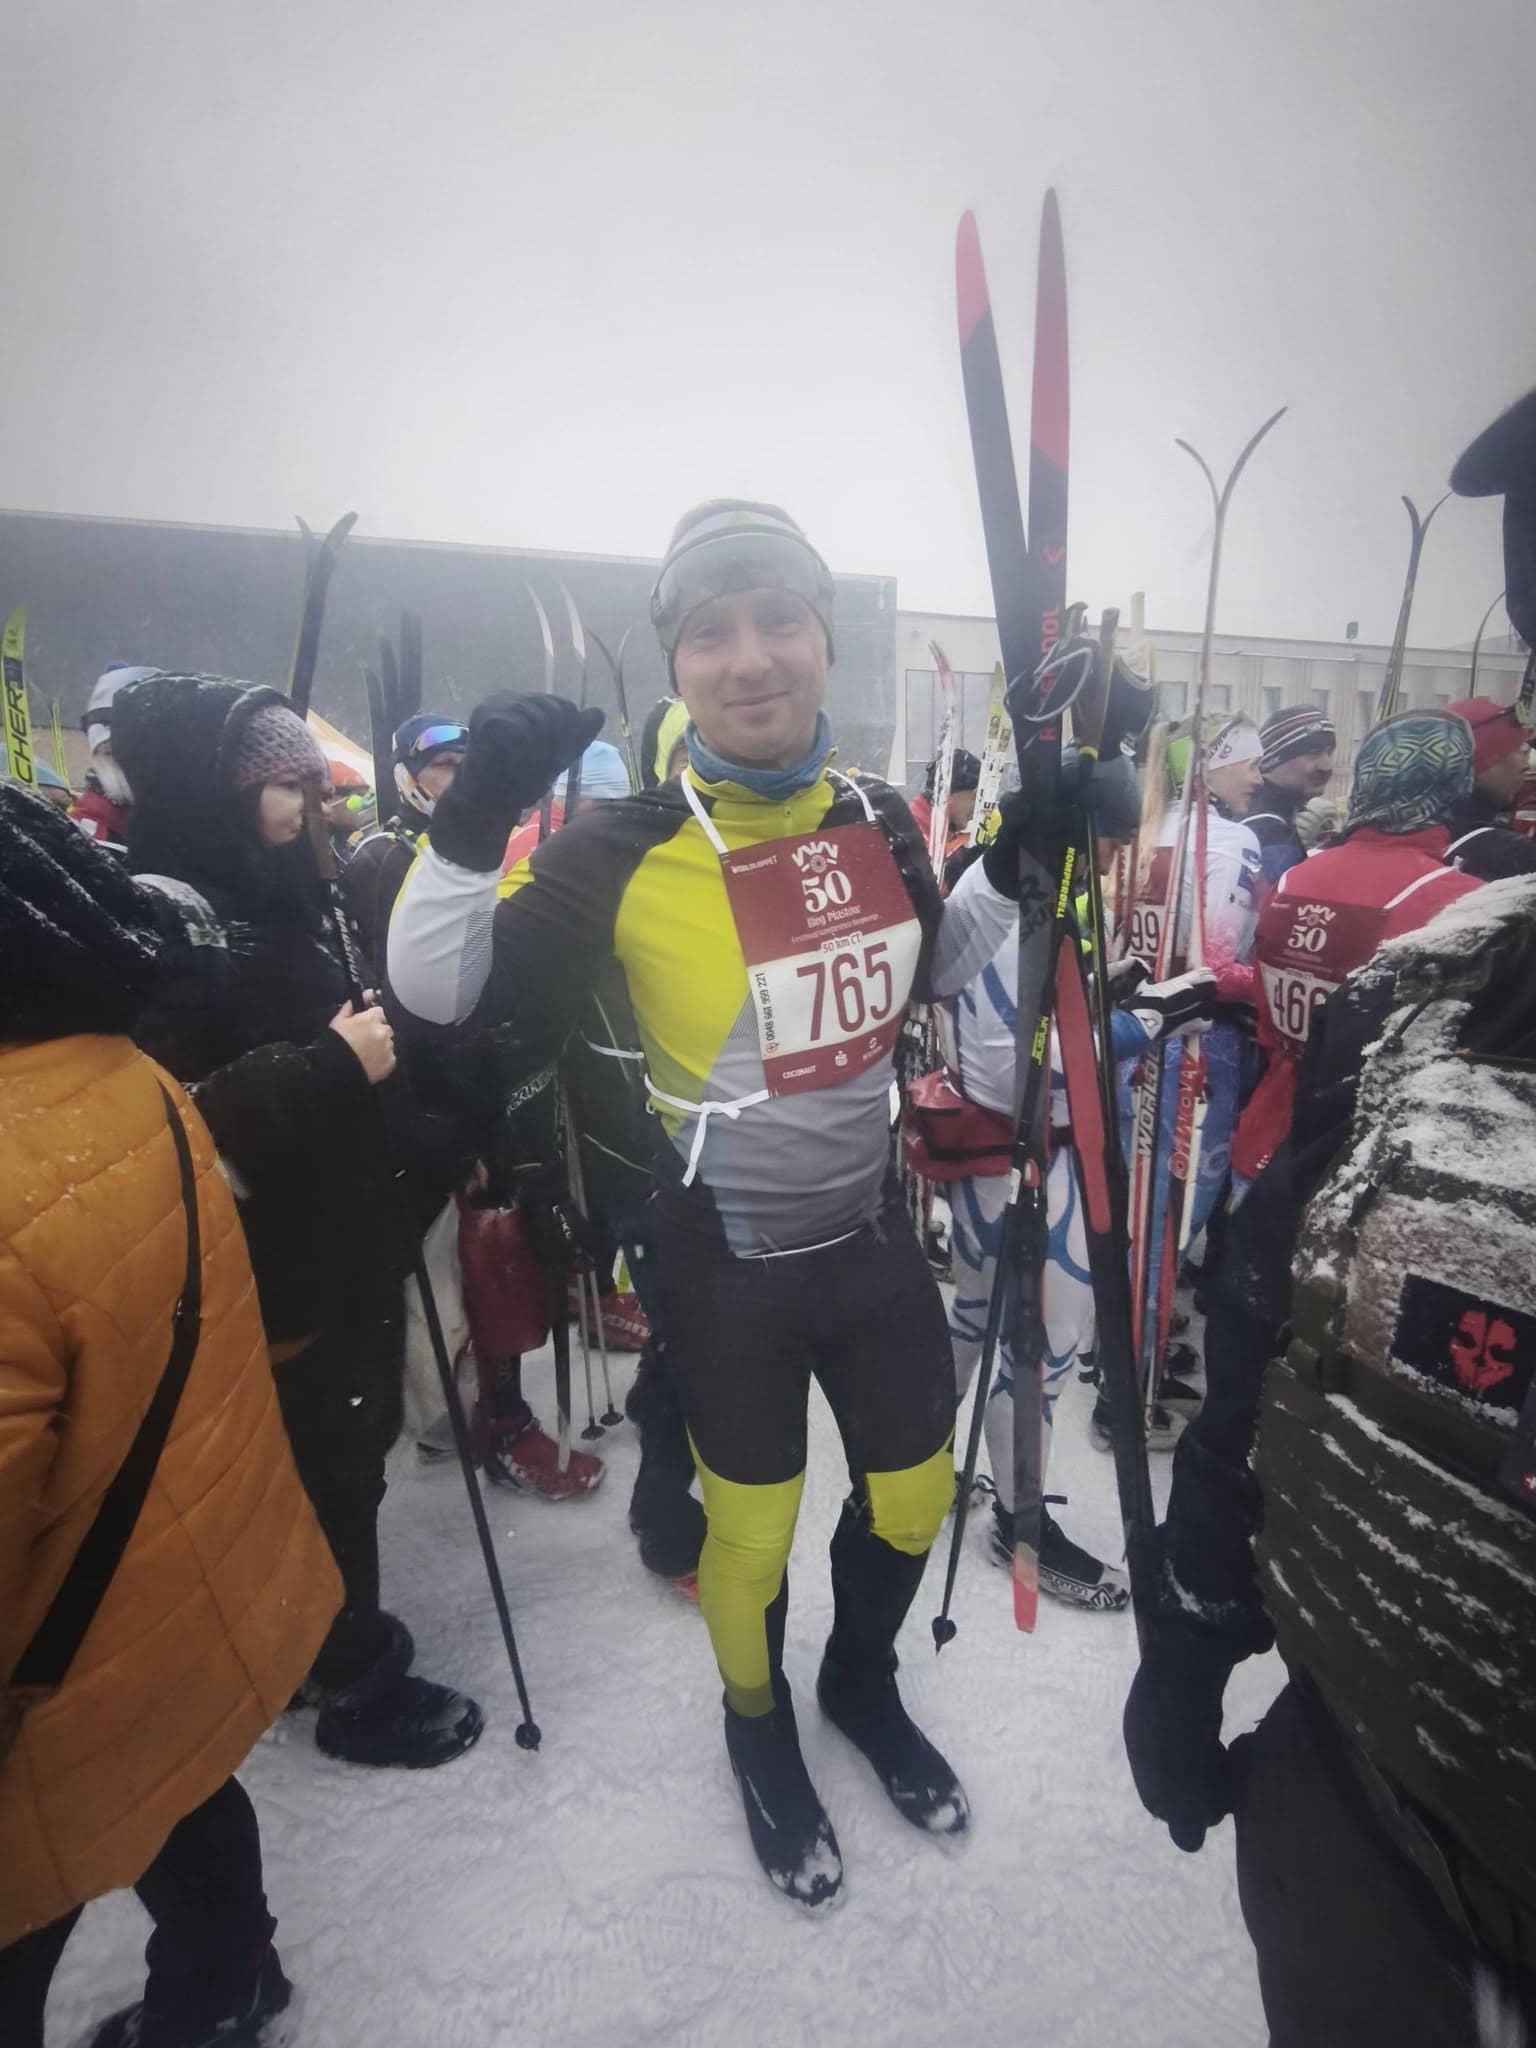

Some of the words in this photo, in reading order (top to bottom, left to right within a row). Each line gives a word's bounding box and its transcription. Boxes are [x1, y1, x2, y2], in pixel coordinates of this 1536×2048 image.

[801, 870, 852, 913] 50
[1056, 846, 1076, 919] KOMPERDELL
[823, 942, 835, 954] 50
[850, 933, 862, 945] CT
[1287, 924, 1328, 953] 50
[796, 941, 893, 1042] 765
